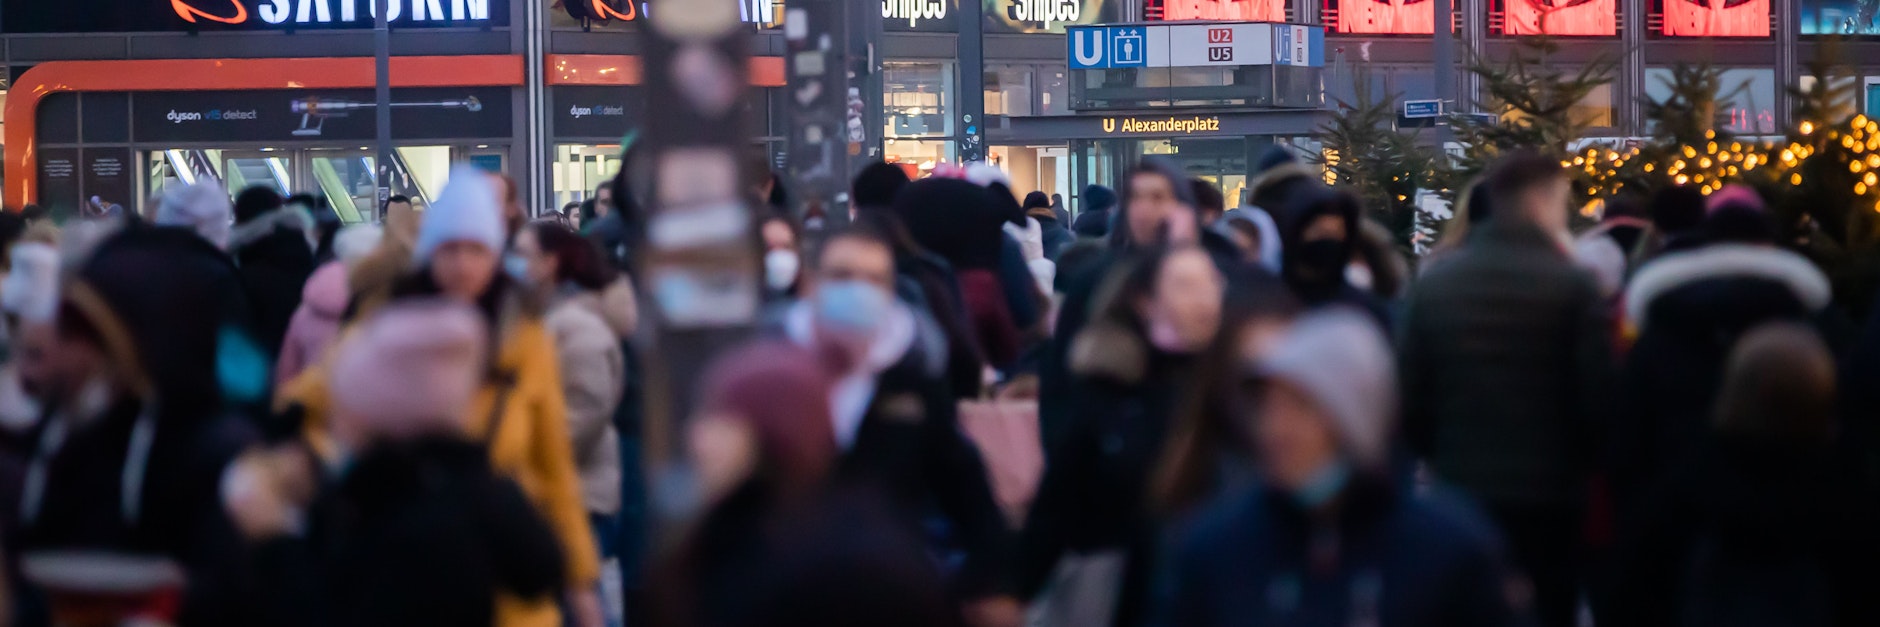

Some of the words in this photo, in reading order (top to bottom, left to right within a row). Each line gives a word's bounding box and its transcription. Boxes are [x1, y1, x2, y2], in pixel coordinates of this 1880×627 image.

[1211, 29, 1231, 43] U2
[1074, 30, 1103, 66] U
[1211, 47, 1231, 61] U5
[167, 109, 201, 124] dyson
[222, 109, 257, 120] detect
[570, 104, 592, 119] dyson
[1103, 118, 1115, 133] U
[1121, 116, 1220, 134] Alexanderplatz
